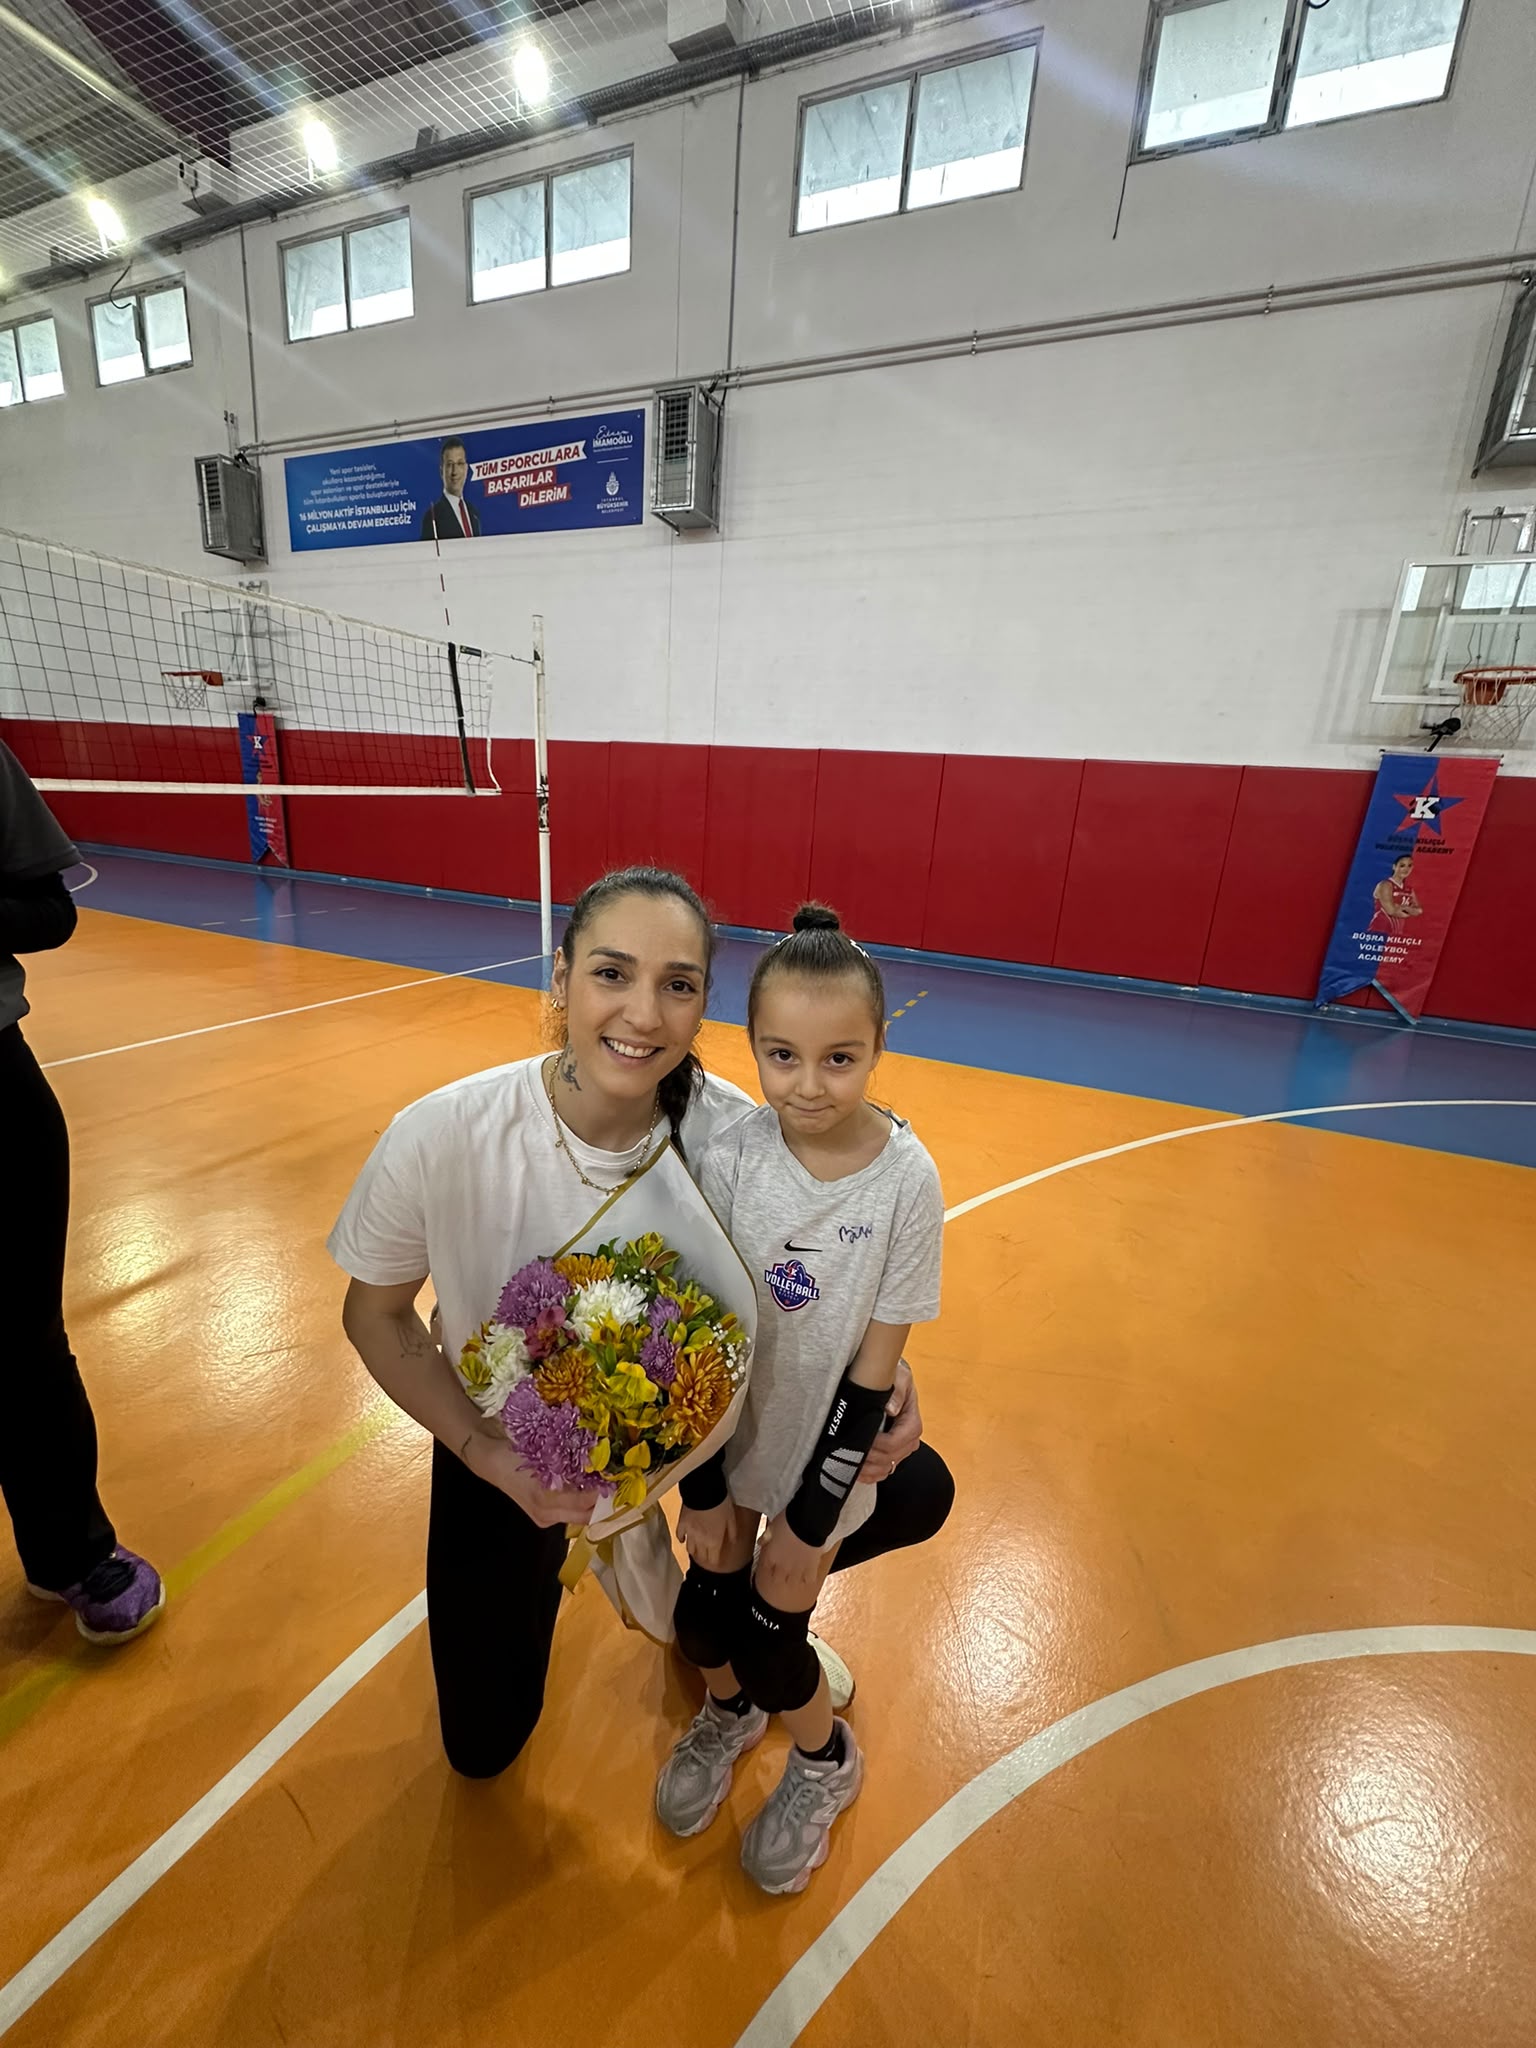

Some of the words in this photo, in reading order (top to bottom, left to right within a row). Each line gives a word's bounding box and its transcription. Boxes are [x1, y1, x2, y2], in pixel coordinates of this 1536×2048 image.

[593, 434, 634, 448] İMAMOĞLU
[475, 460, 498, 478] TÜM
[500, 445, 580, 472] SPORCULARA
[487, 470, 553, 494] BAŞARILAR
[520, 486, 568, 507] DİLERİM
[307, 509, 333, 521] MİLYON
[334, 505, 354, 518] AKTİF
[355, 503, 400, 516] İSTANBULLU
[400, 499, 417, 512] İÇİN
[306, 521, 347, 535] ÇALIŞMAYA
[347, 519, 374, 530] DEVAM
[375, 513, 412, 527] EDECEĞİZ
[253, 735, 263, 749] K
[1410, 796, 1440, 819] K
[1352, 932, 1384, 942] BÜŞRA
[1387, 936, 1422, 946] KILIÇLI
[1360, 943, 1408, 955] VOLEYBOL
[1358, 953, 1404, 964] ACADEMY
[765, 1271, 819, 1299] VOLLEYBALL
[828, 1398, 848, 1436] KIPSTA
